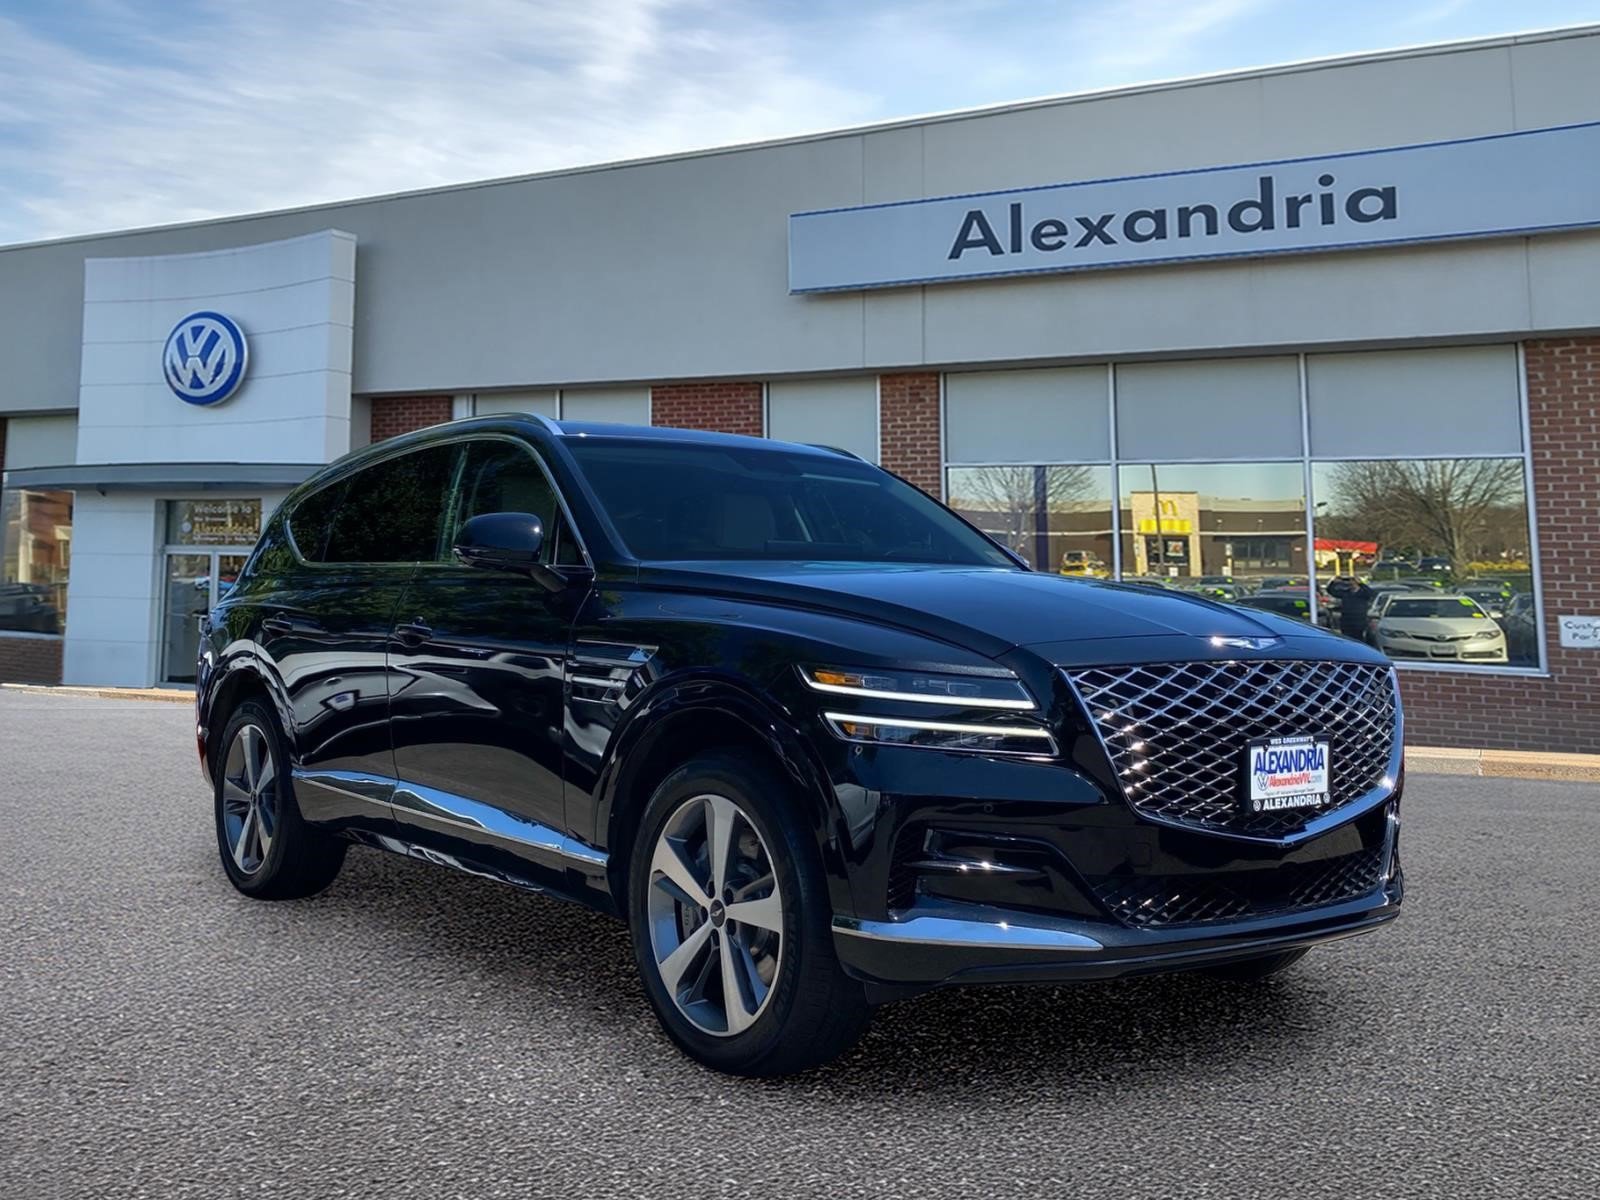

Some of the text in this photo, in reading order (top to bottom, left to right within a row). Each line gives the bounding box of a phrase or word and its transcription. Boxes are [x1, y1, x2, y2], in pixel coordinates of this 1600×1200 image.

[948, 174, 1398, 260] Alexandria
[1254, 748, 1325, 775] ALEXANDRIA
[1263, 793, 1322, 811] ALEXANDRIA
